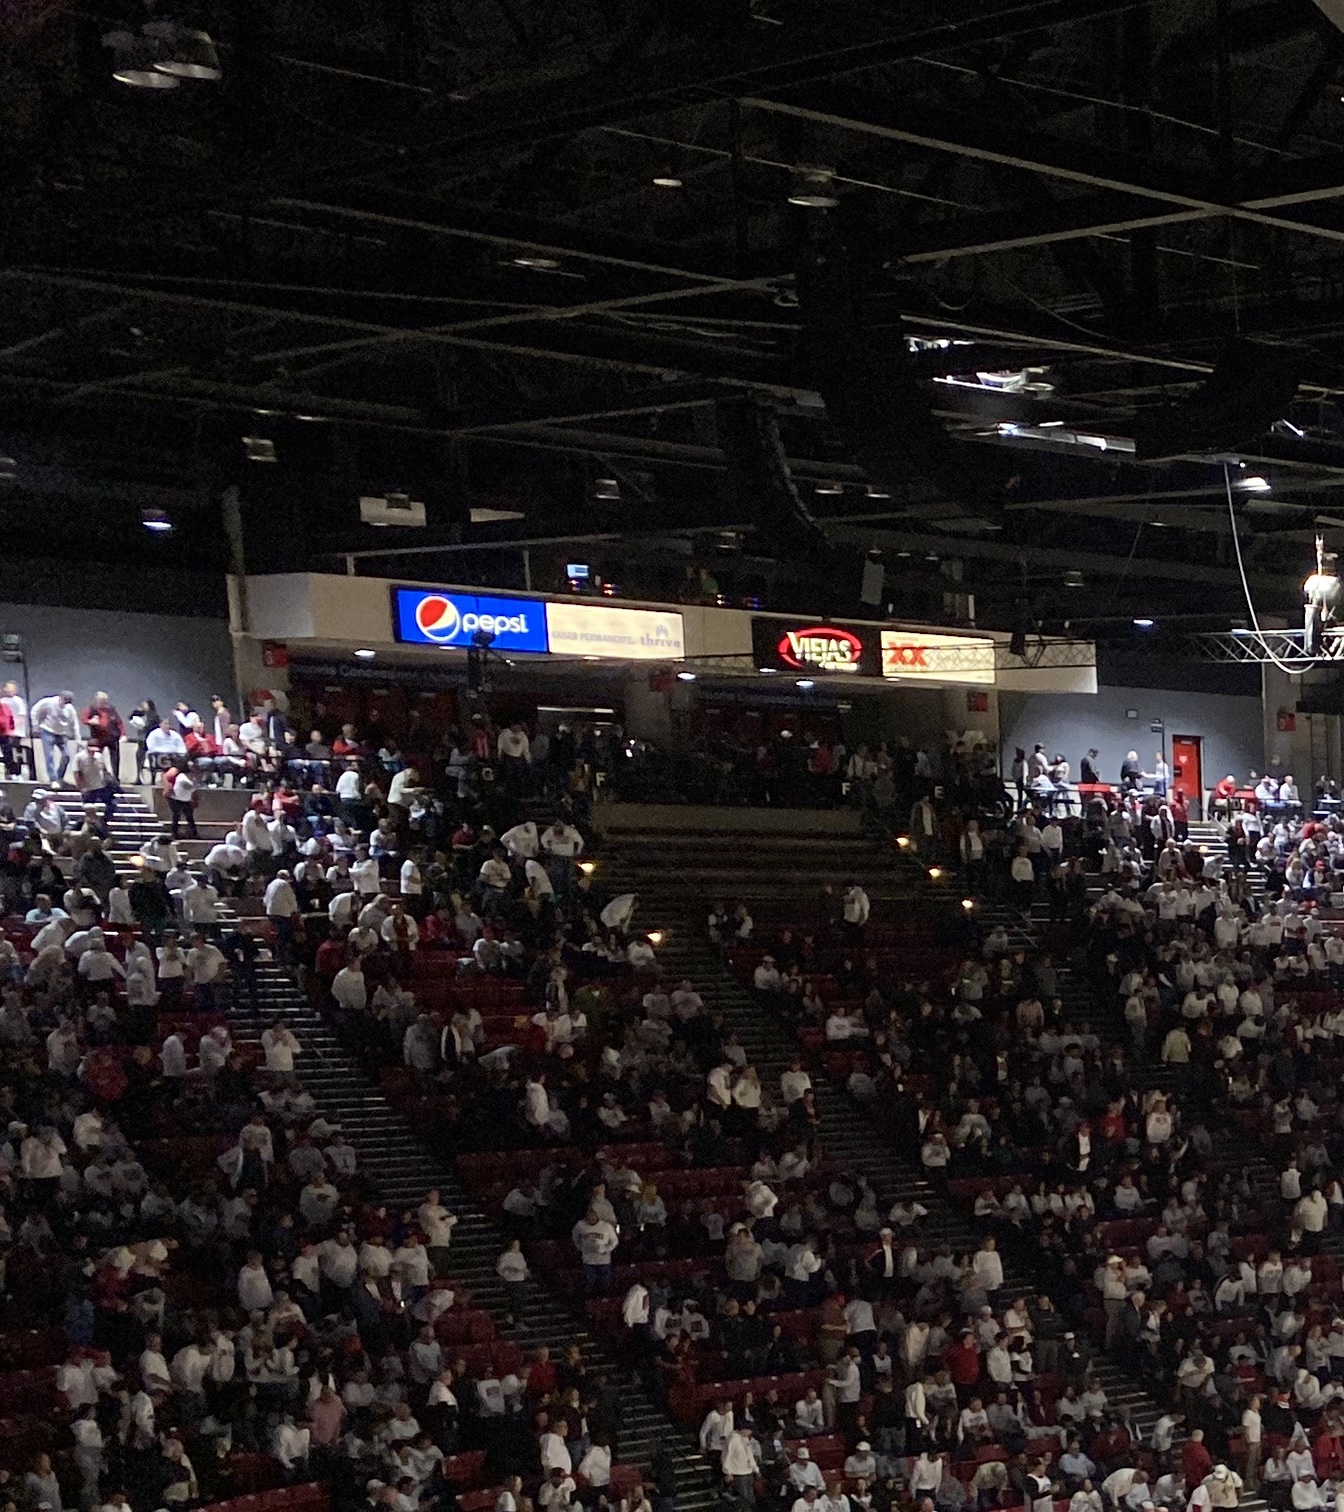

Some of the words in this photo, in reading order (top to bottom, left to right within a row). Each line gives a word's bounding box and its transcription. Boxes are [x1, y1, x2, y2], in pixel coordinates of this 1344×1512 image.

[462, 613, 528, 637] pepsi
[786, 631, 851, 664] VIEJAS
[887, 642, 928, 666] XX
